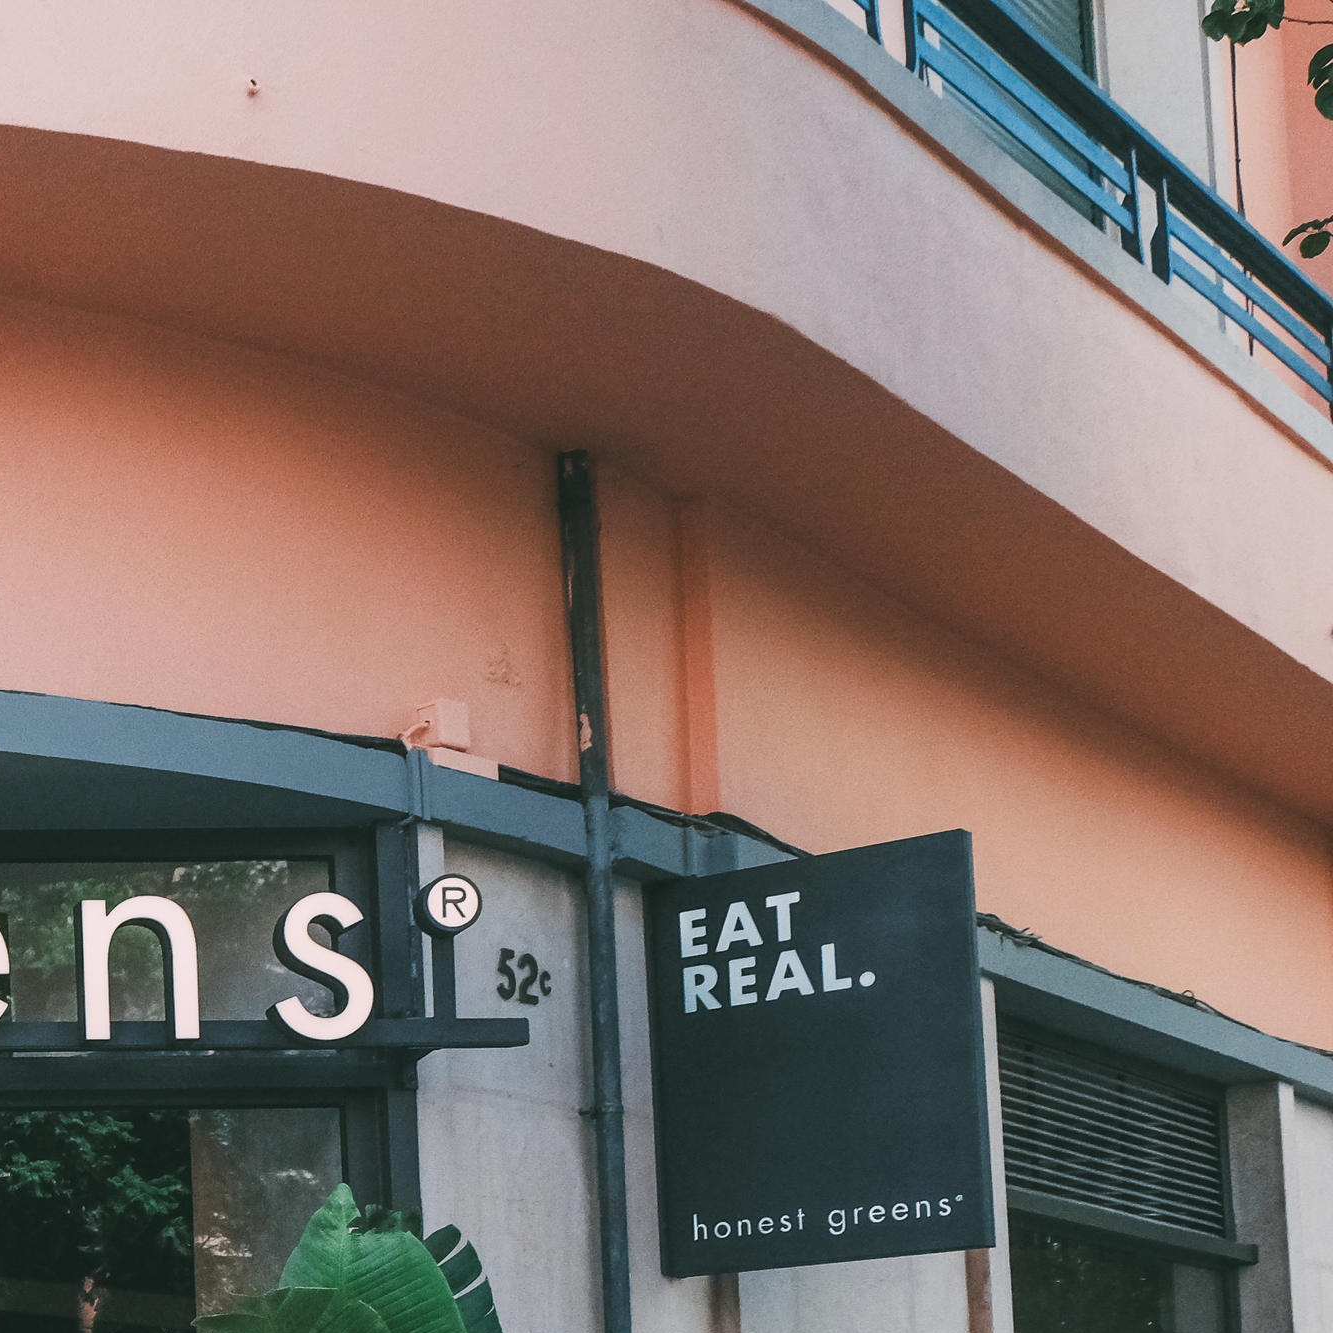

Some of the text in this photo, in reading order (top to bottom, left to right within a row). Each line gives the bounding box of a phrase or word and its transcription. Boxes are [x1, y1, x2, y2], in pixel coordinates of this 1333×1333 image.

[678, 891, 801, 959] EAT
[682, 943, 876, 1014] REAL.
[692, 1208, 806, 1241] honest
